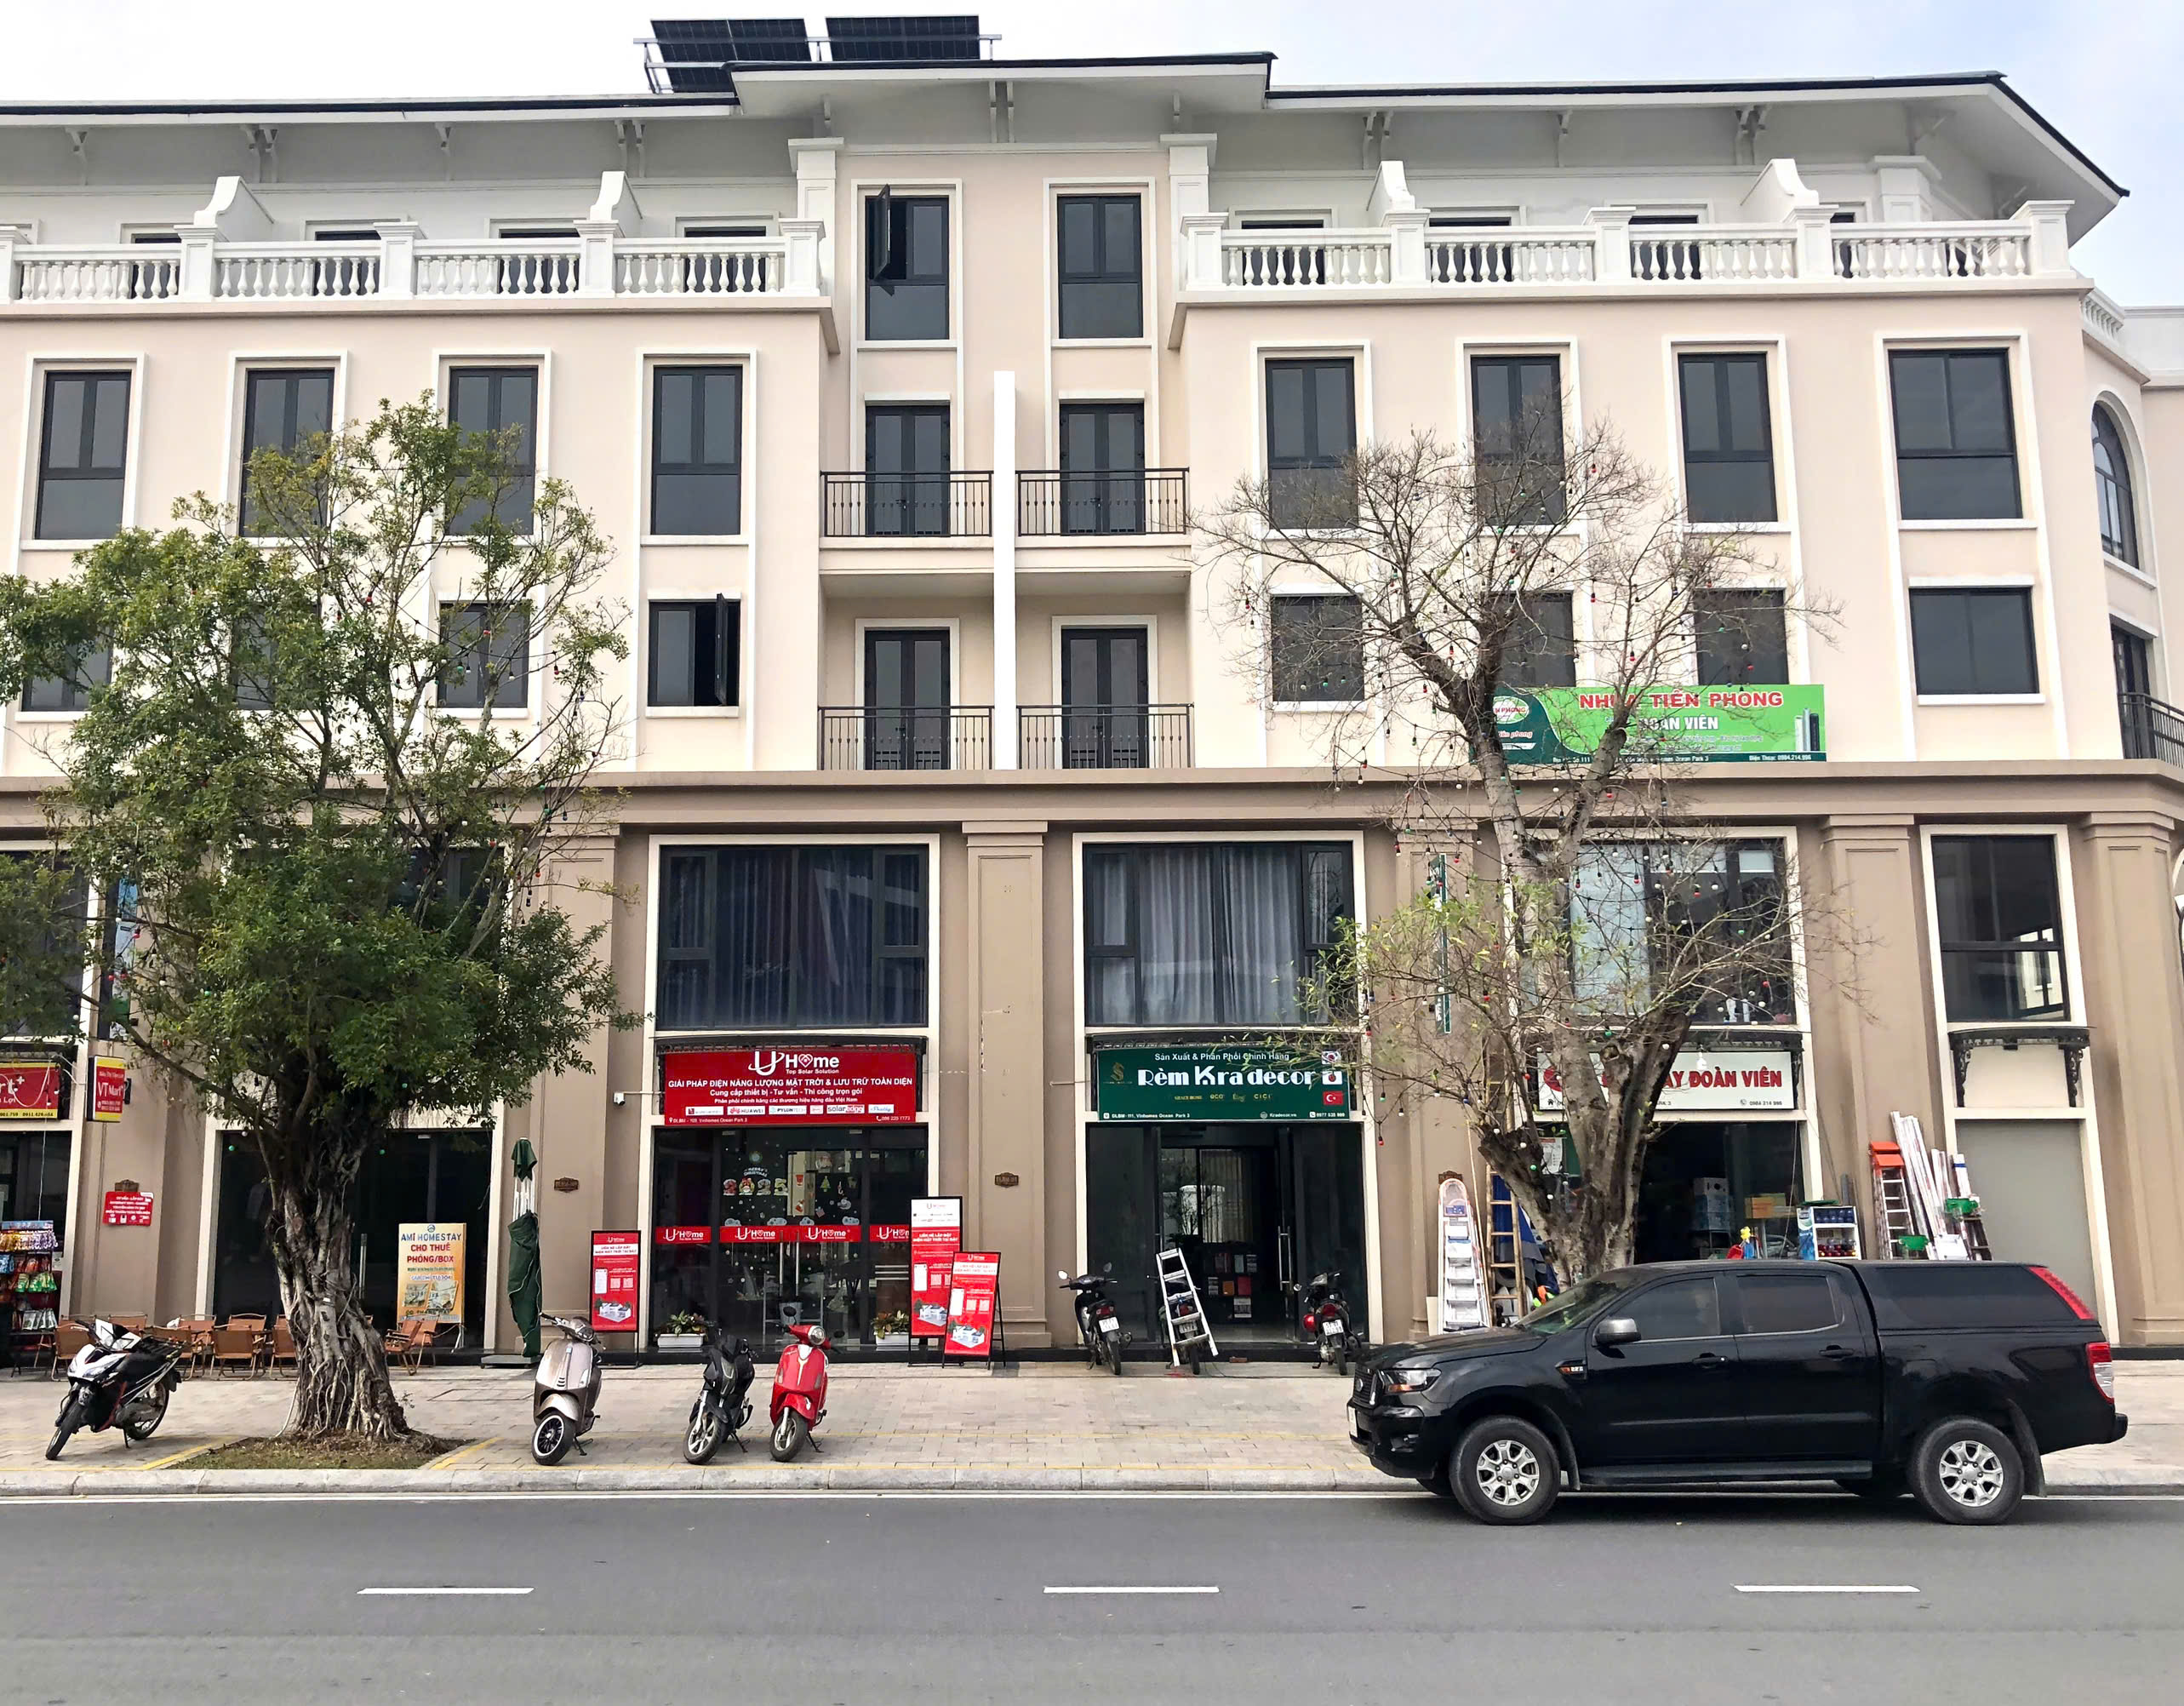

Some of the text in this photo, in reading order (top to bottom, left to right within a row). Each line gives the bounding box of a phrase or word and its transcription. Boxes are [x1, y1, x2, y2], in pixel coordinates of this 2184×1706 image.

[1709, 691, 1783, 707] PHONG
[1684, 714, 1718, 730] VIÊN
[1154, 1052, 1169, 1061] Sản
[1172, 1052, 1190, 1061] Xuất
[668, 1079, 684, 1088] GIẢI
[686, 1078, 708, 1087] PHÁP
[709, 1079, 729, 1088] ĐIỆN
[729, 1078, 752, 1086] NĂNG
[754, 1079, 784, 1089] LƯỢNG
[786, 1078, 803, 1088] MẶT
[804, 1078, 824, 1086] TRỜI
[871, 1076, 892, 1085] TOÀN
[1137, 1068, 1190, 1086] Rèm
[1689, 1066, 1736, 1088] ĐOÀN
[1741, 1066, 1782, 1088] VIÊN
[97, 1081, 109, 1096] VT
[729, 1088, 743, 1096] cấp
[817, 1088, 834, 1096] công
[851, 1088, 863, 1096] gói
[417, 1233, 461, 1241] HOMESTAY
[429, 1242, 451, 1251] THUÊ
